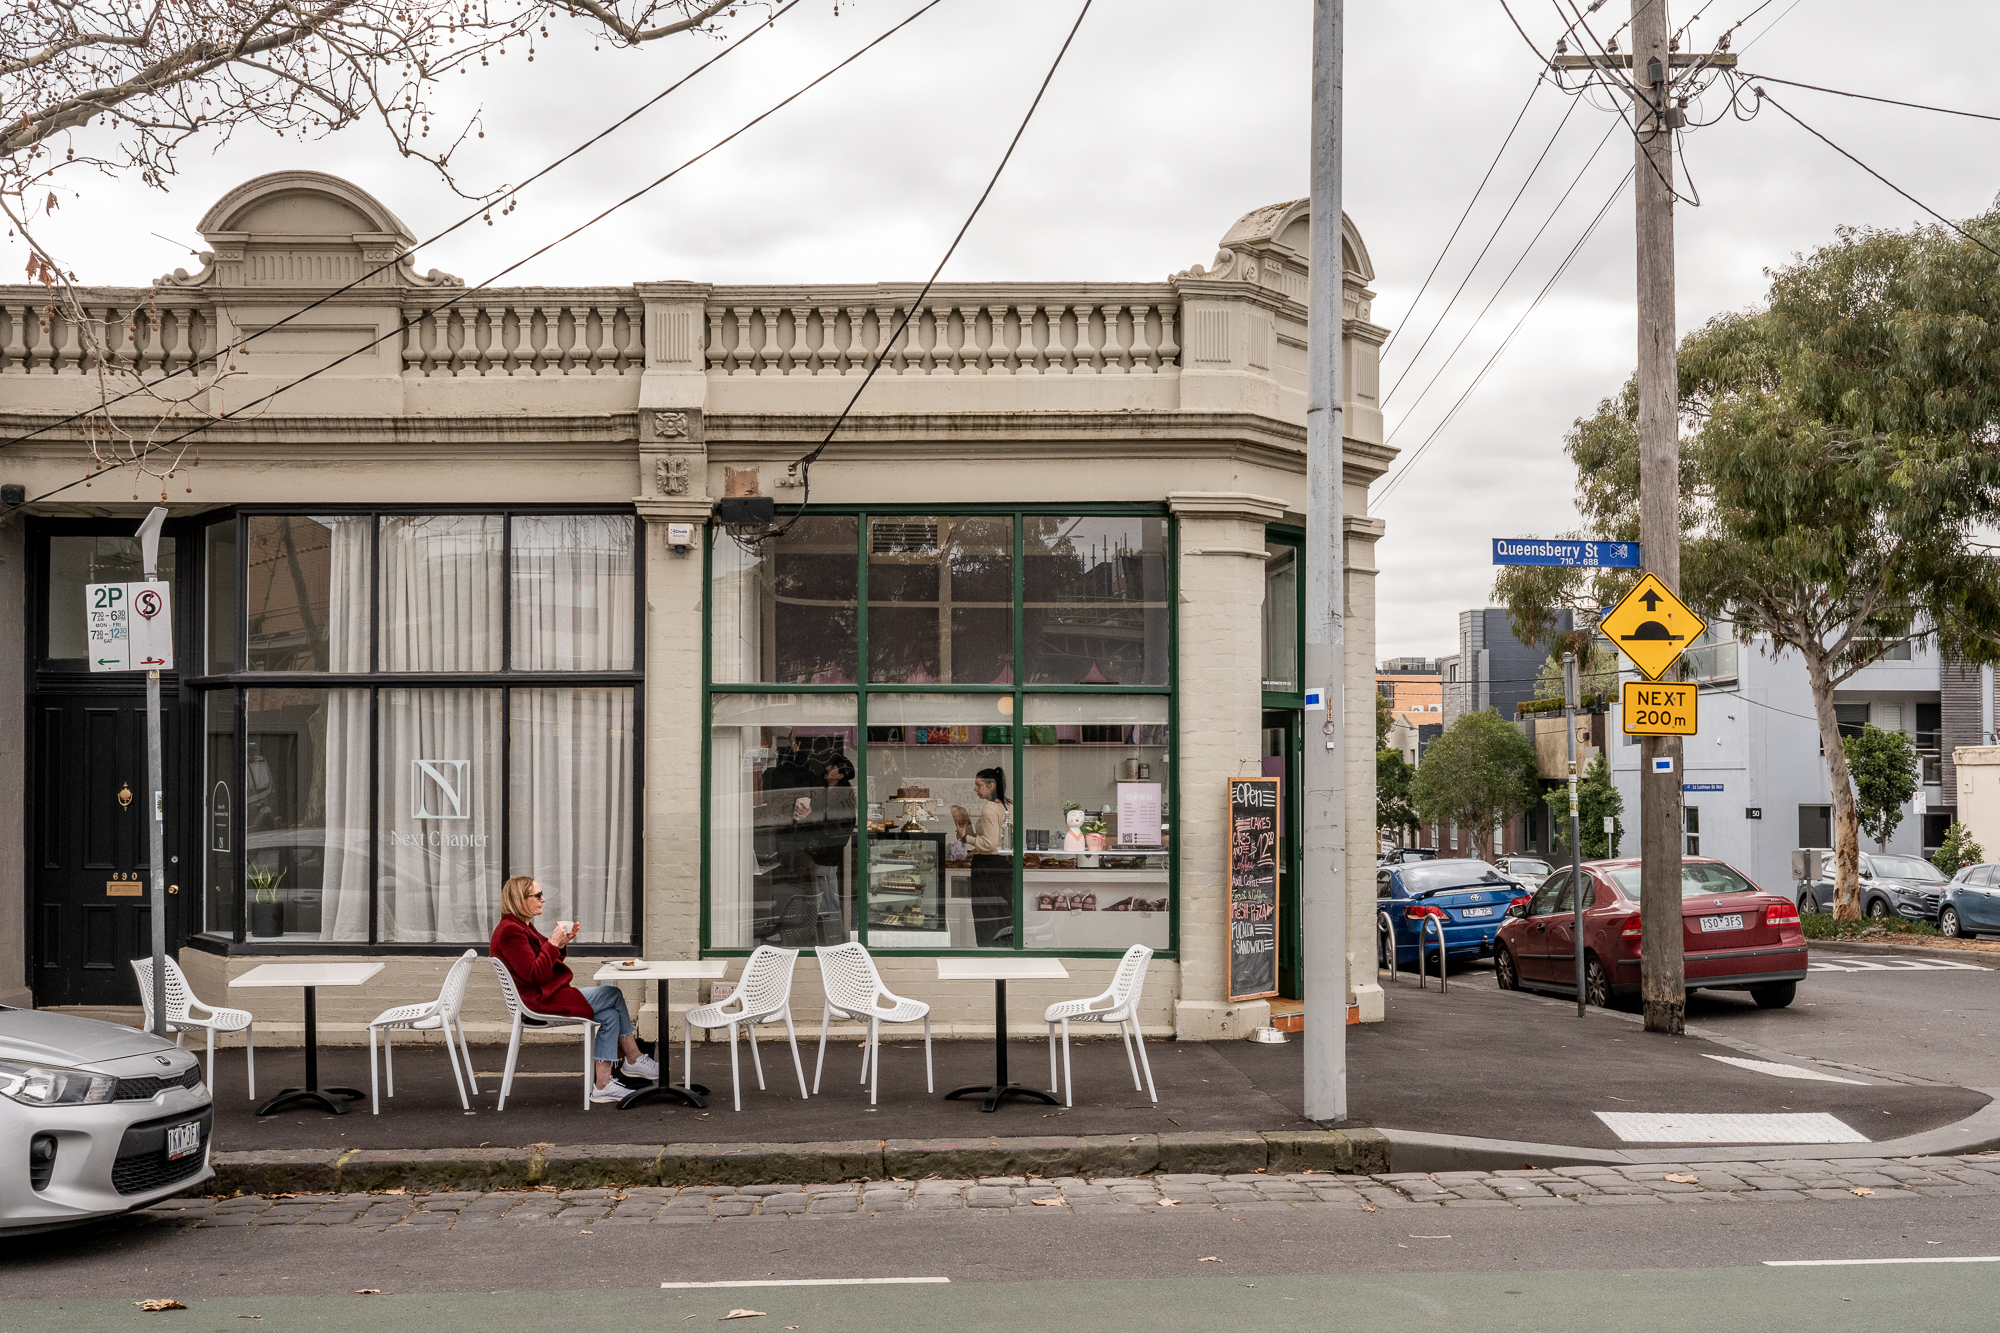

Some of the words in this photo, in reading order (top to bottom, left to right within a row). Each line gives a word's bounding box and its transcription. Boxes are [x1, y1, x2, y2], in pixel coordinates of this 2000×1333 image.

[1497, 540, 1580, 559] Queensberry
[1585, 542, 1598, 558] St
[94, 588, 122, 608] 2P
[1638, 691, 1686, 706] NEXT
[1250, 816, 1271, 830] CAKES
[390, 830, 425, 846] Next
[429, 830, 488, 850] Chapter
[112, 872, 138, 880] 690
